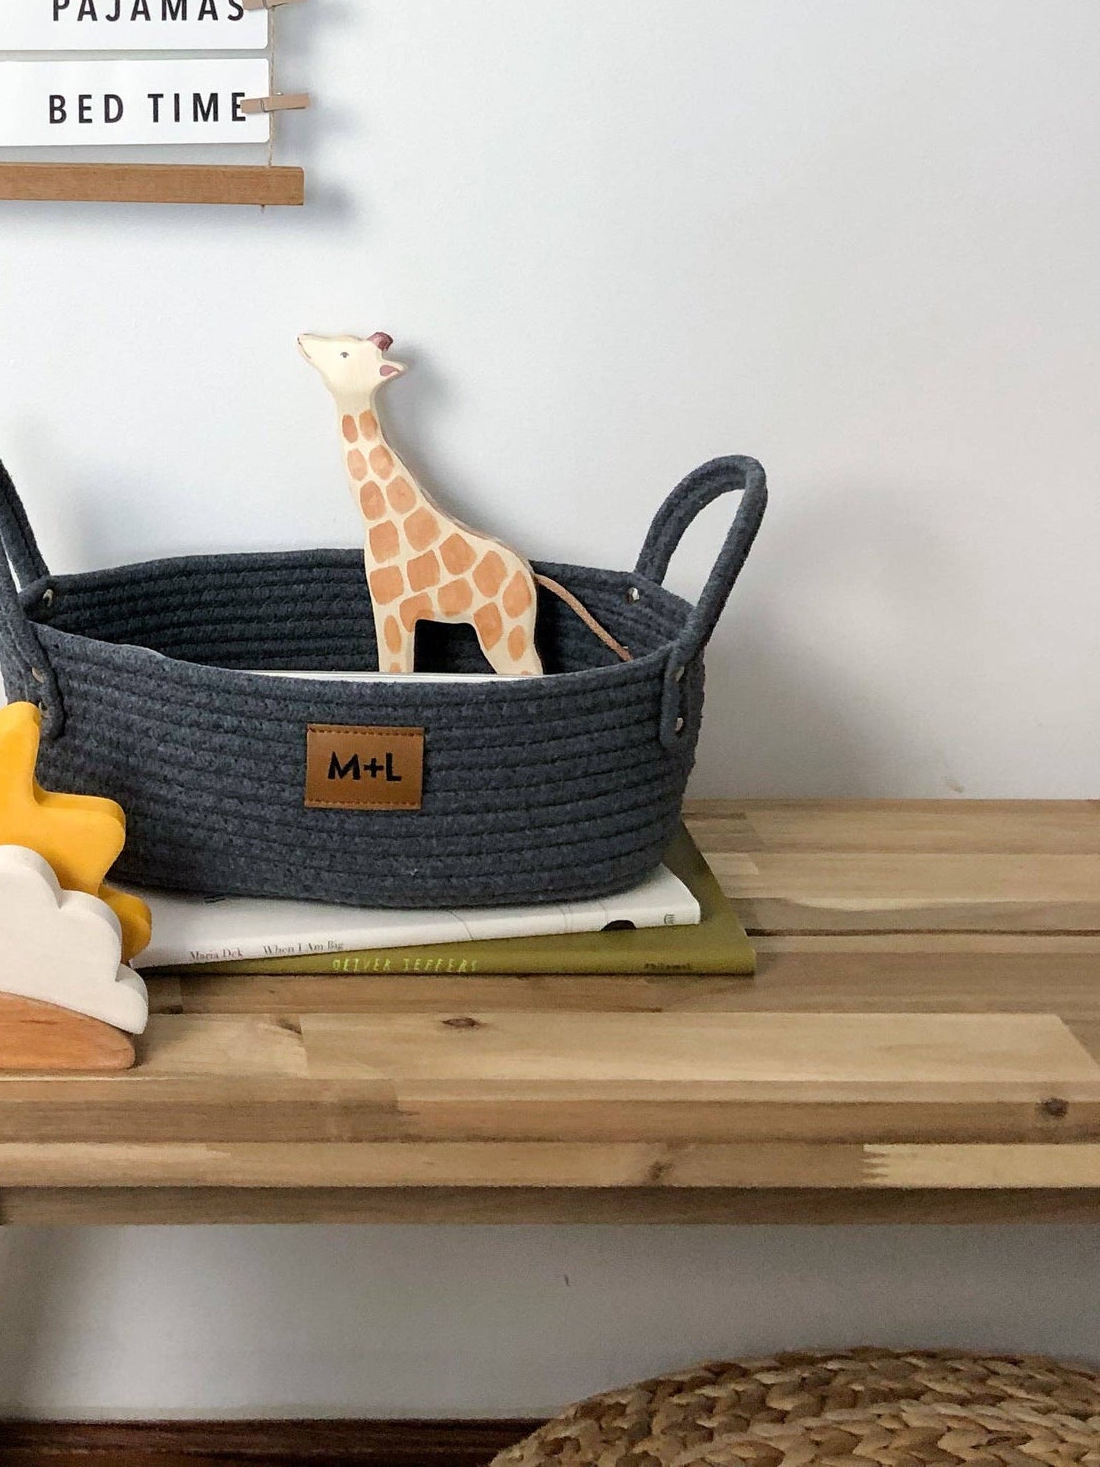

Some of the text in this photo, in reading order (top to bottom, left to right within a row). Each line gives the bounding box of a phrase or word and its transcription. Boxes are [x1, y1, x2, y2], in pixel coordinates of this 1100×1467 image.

[49, 92, 246, 124] BED TIME
[327, 751, 402, 782] M+L
[189, 949, 219, 961] Maria
[263, 944, 295, 955] When
[306, 942, 324, 952] Am
[327, 940, 344, 950] Big
